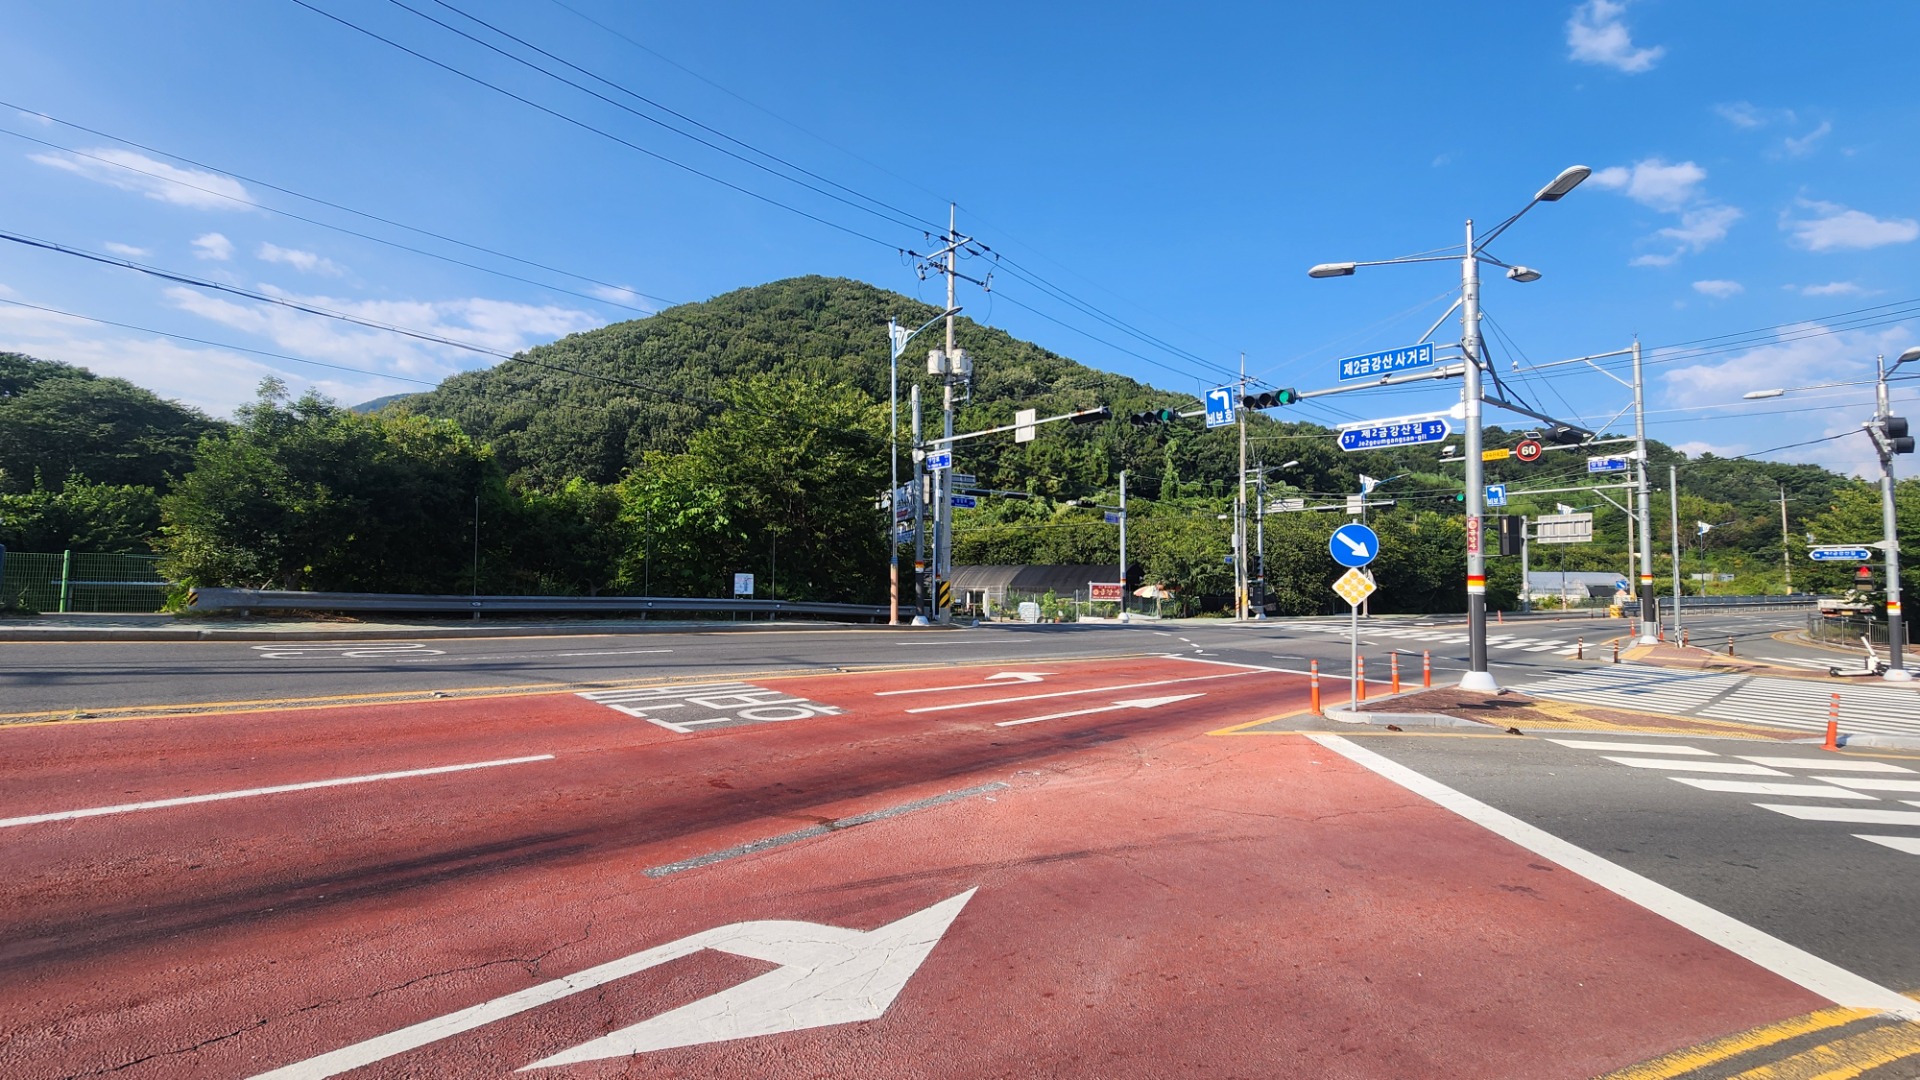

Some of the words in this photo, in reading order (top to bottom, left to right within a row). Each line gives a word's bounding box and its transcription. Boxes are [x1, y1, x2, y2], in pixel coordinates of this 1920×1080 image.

[1343, 354, 1393, 376] 제2금강산
[1395, 346, 1430, 367] 사거리
[1207, 409, 1234, 425] 비보호
[1361, 422, 1423, 439] 제2금강산길
[1429, 424, 1443, 434] 33
[1344, 434, 1356, 444] 37
[1521, 445, 1537, 456] 60
[1487, 496, 1506, 507] 비보호
